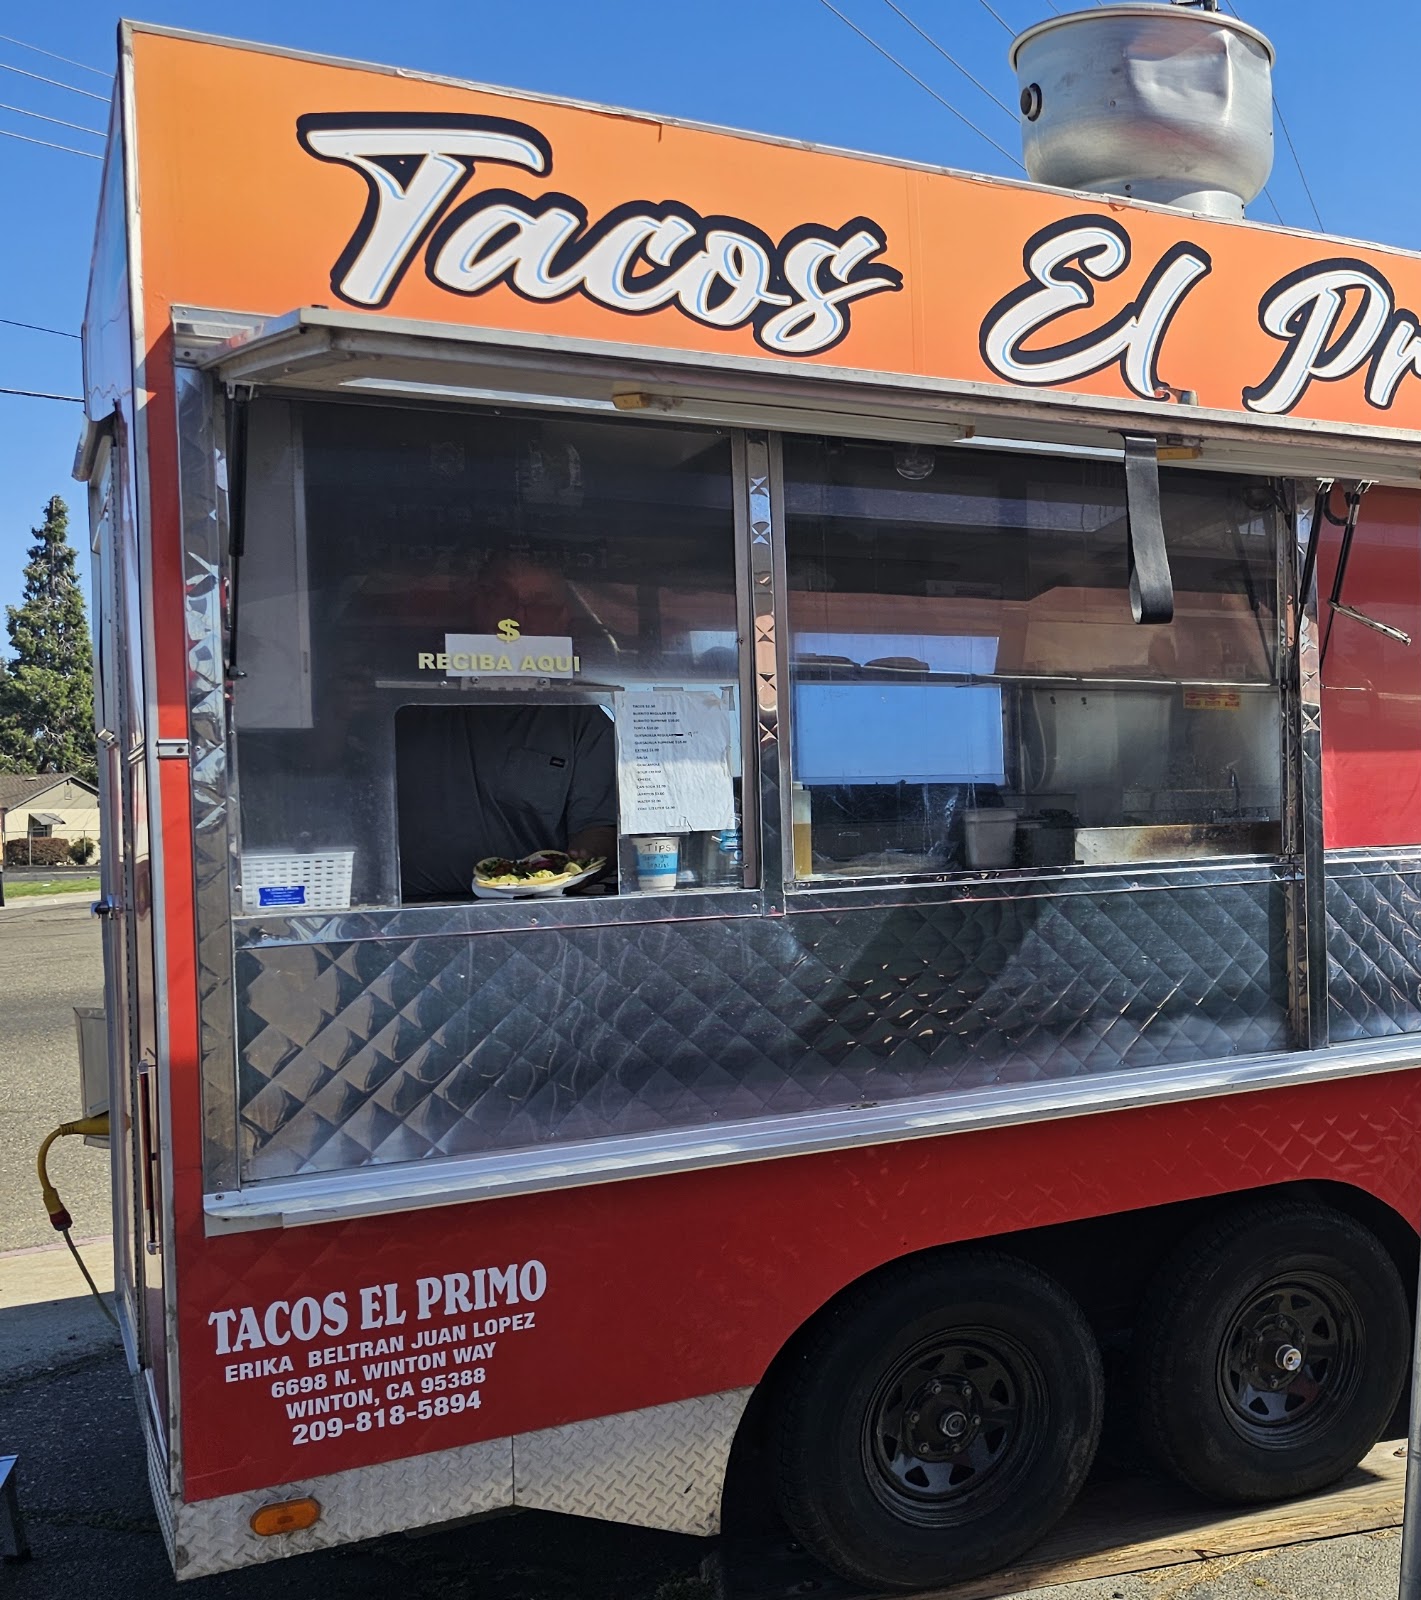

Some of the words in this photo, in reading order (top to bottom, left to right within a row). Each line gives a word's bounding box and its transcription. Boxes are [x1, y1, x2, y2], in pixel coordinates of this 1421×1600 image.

[296, 112, 903, 356] Tacos
[979, 213, 1211, 400] El
[418, 652, 513, 671] RECIBA
[520, 655, 580, 672] AQUI
[208, 1291, 348, 1355] TACOS
[360, 1283, 406, 1331] EL
[416, 1259, 547, 1320] PRIMO
[225, 1355, 294, 1383] ERIKA
[308, 1335, 404, 1369] BELTRAN
[411, 1325, 466, 1349] JUAN
[473, 1312, 536, 1339] LOPEZ
[271, 1376, 328, 1399] 6698
[335, 1369, 357, 1388] N.
[363, 1351, 447, 1382] WINTON
[453, 1342, 497, 1365] WAY
[286, 1388, 380, 1420] WINTON,
[386, 1380, 414, 1400] CA
[421, 1367, 486, 1394] 95388
[292, 1390, 482, 1446] 209-818-5894
